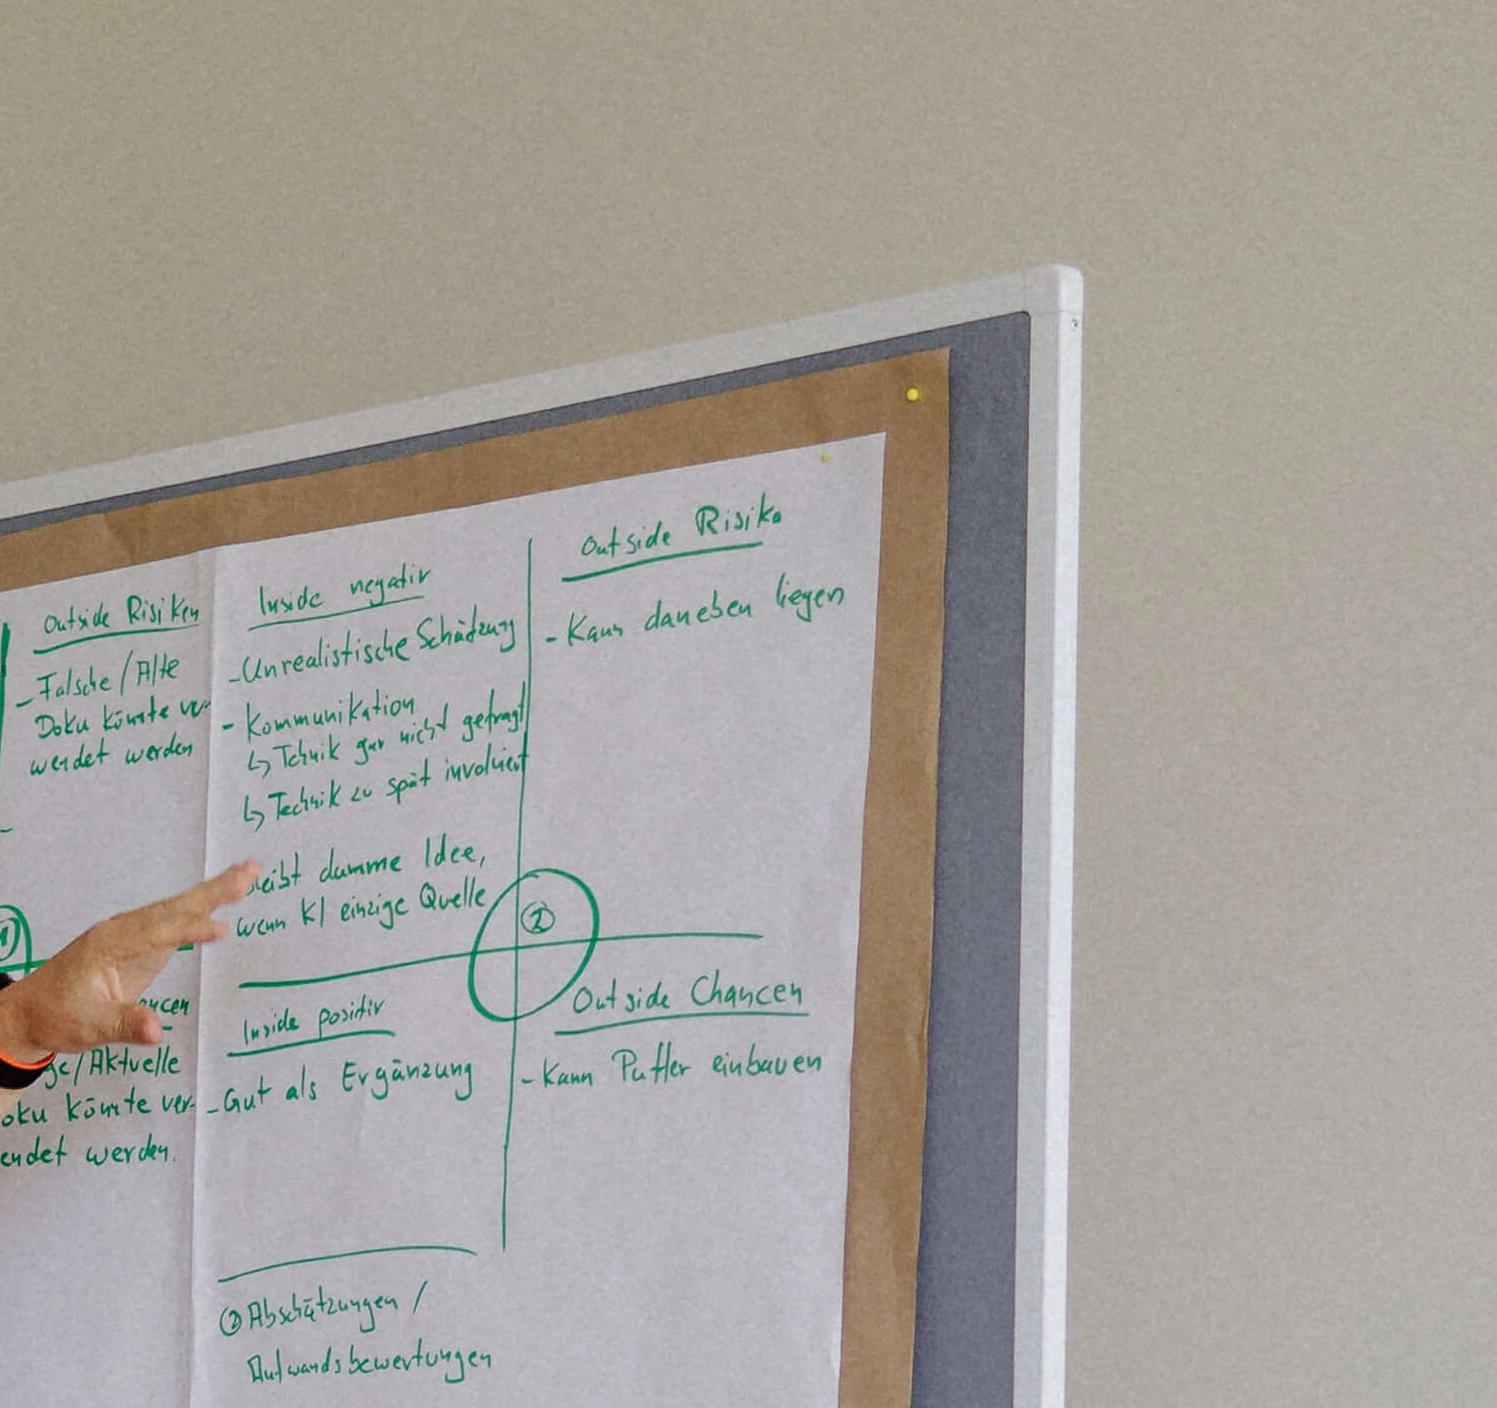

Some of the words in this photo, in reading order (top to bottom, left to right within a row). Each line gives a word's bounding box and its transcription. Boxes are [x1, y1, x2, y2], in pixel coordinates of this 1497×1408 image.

[695, 492, 782, 536] Risiko
[127, 593, 200, 625] Risiken
[691, 969, 803, 1006] Chancen
